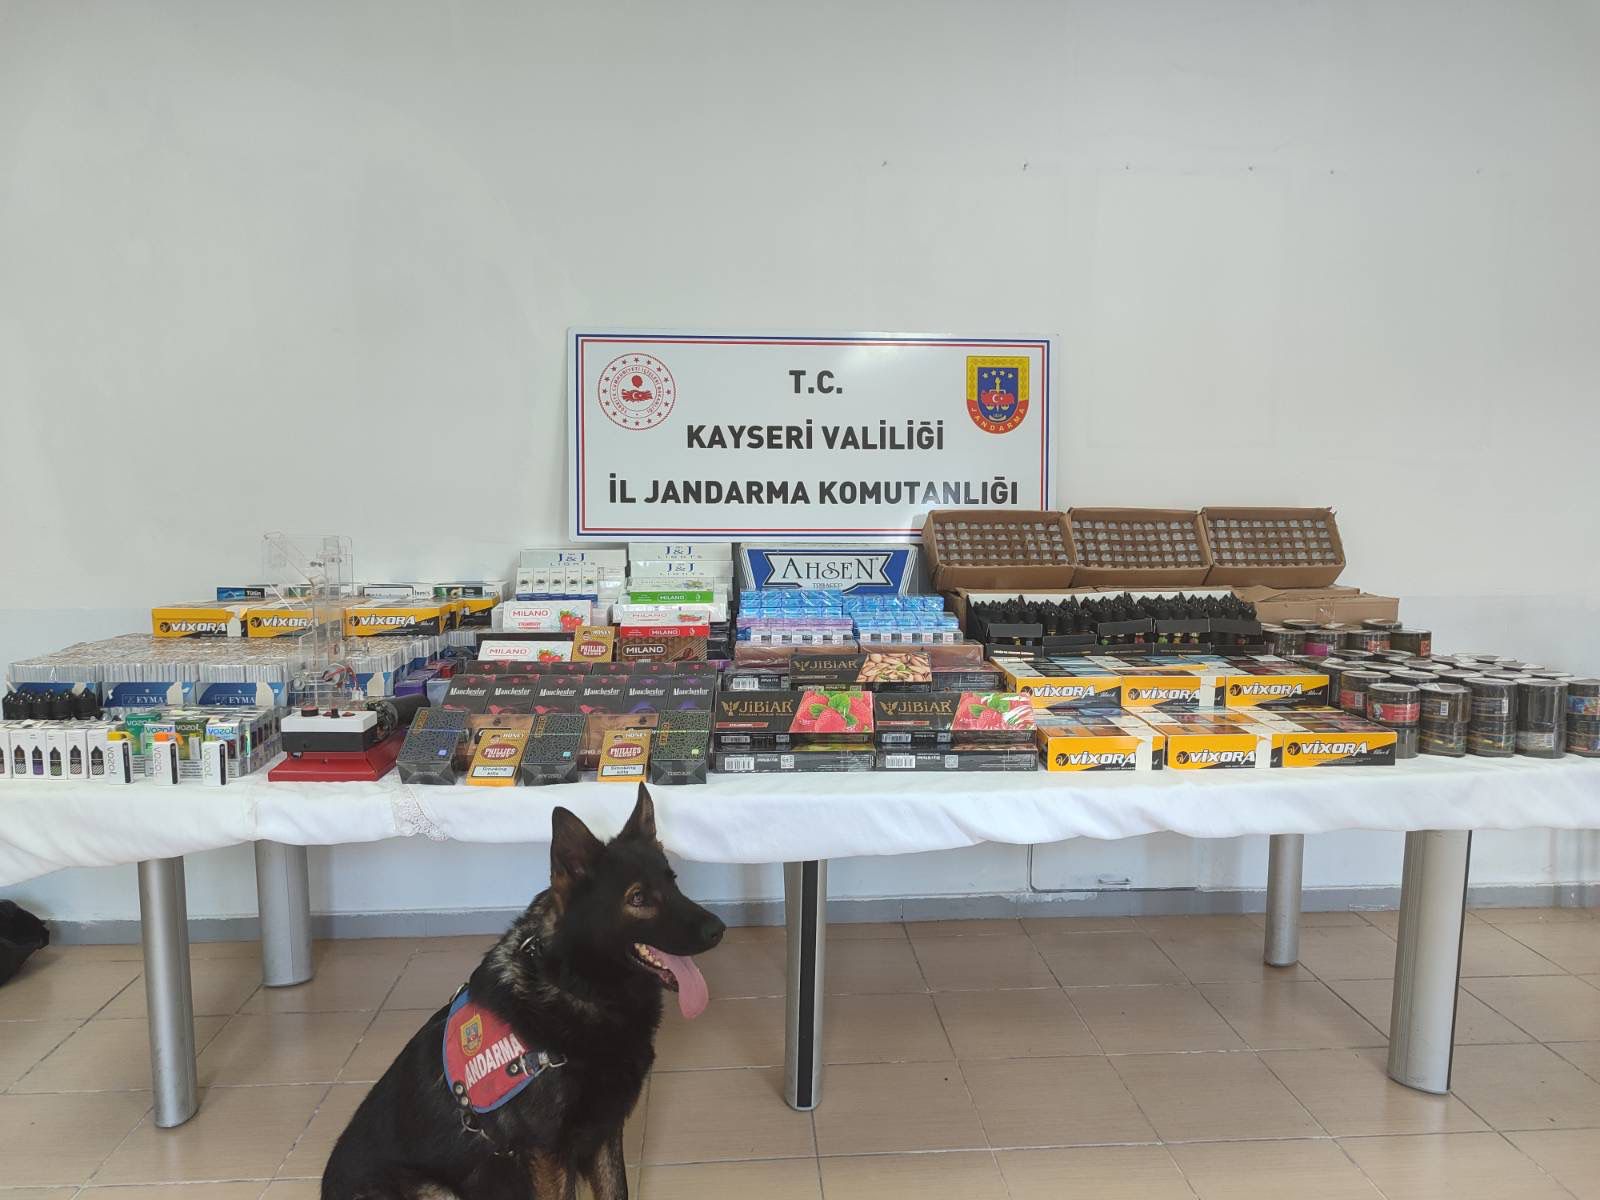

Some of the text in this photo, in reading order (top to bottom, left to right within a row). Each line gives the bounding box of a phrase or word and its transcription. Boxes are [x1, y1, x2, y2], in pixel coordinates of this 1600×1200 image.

[788, 370, 844, 395] T.C.
[970, 407, 1026, 432] JANDARMA
[687, 419, 944, 450] KAYSERİ VALİLİĞİ
[608, 473, 1019, 505] İL JANDARMA KOMUTANLIĞI
[782, 557, 876, 580] AHSEN
[512, 609, 549, 617] MILANO
[626, 646, 664, 654] MILANO
[450, 687, 487, 696] Manchester
[495, 687, 532, 696] Manchester
[539, 688, 577, 697] Manchester
[583, 687, 621, 696] Manchester
[629, 687, 666, 696] Manchester
[673, 687, 710, 696] Manchester
[484, 747, 516, 756] PHILLIES
[610, 746, 642, 756] PHILLIES
[465, 1032, 526, 1091] ANDARMA
